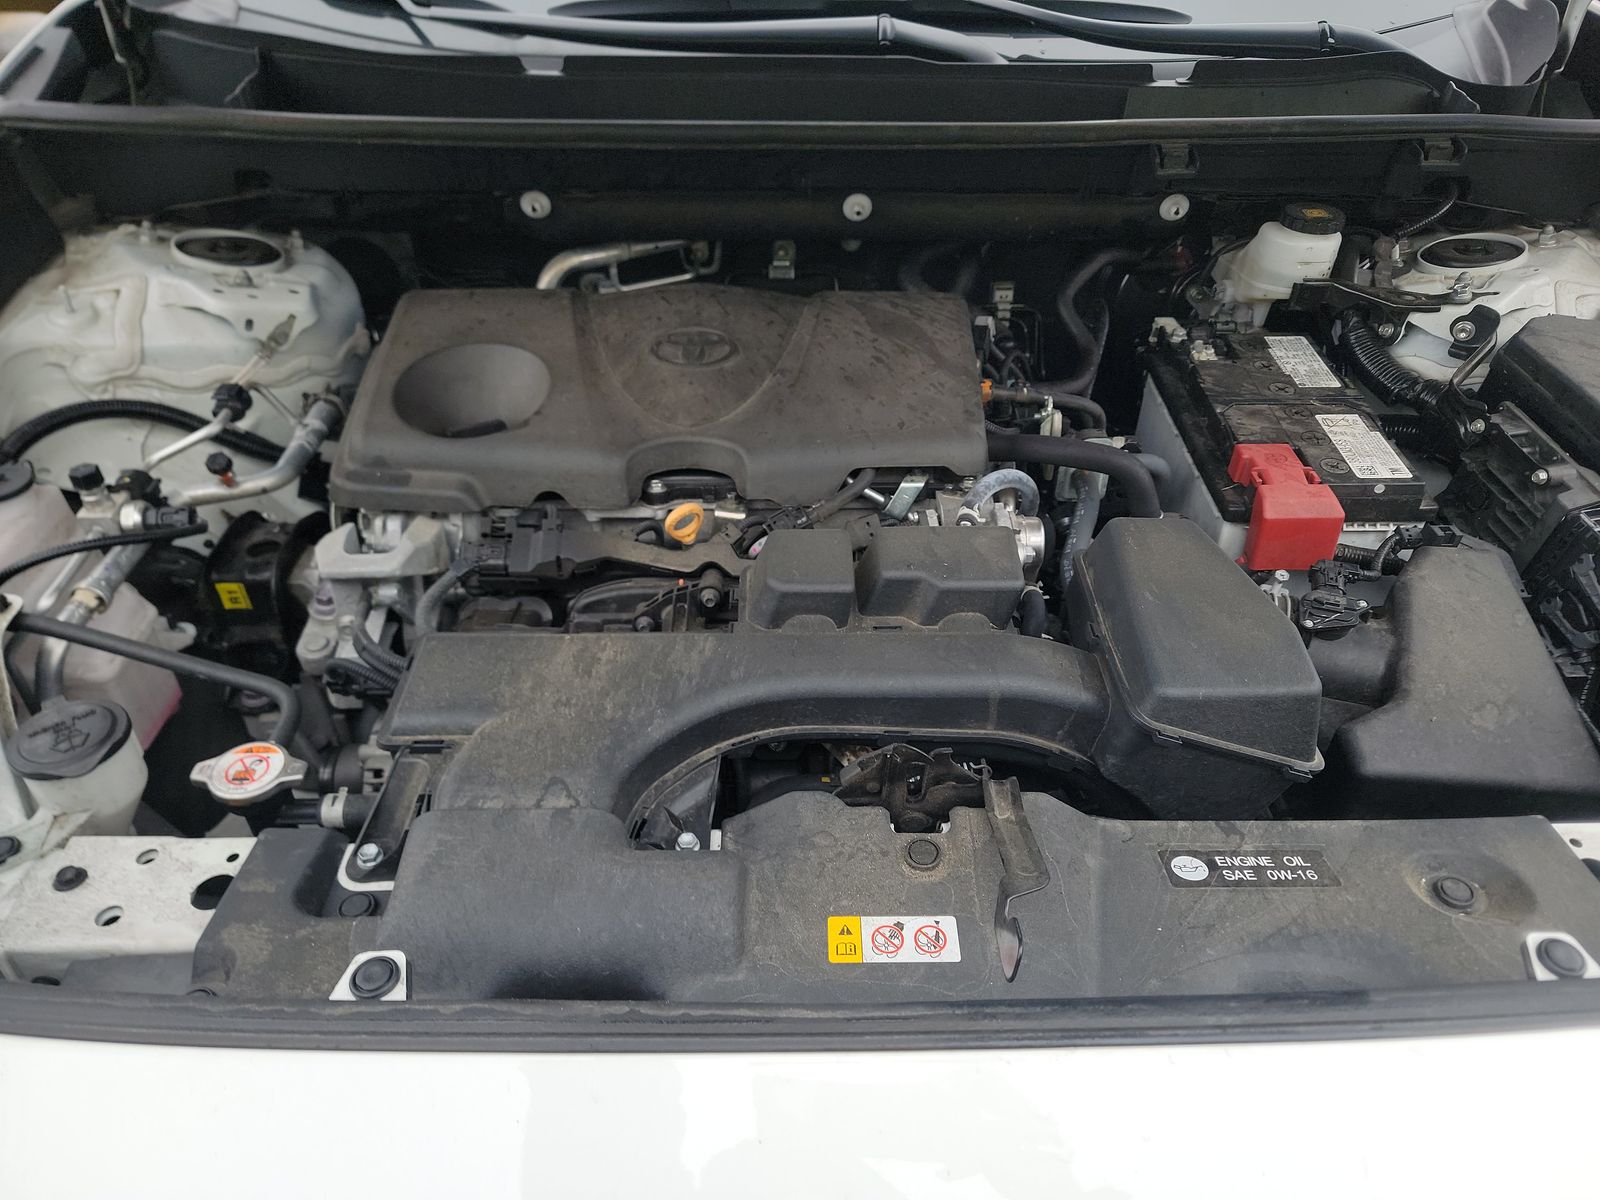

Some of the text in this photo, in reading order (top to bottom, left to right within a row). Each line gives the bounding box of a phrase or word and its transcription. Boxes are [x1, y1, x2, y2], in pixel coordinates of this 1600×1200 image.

[1214, 856, 1311, 867] ENGINE OIL
[1222, 869, 1319, 881] SAE 0W-16
